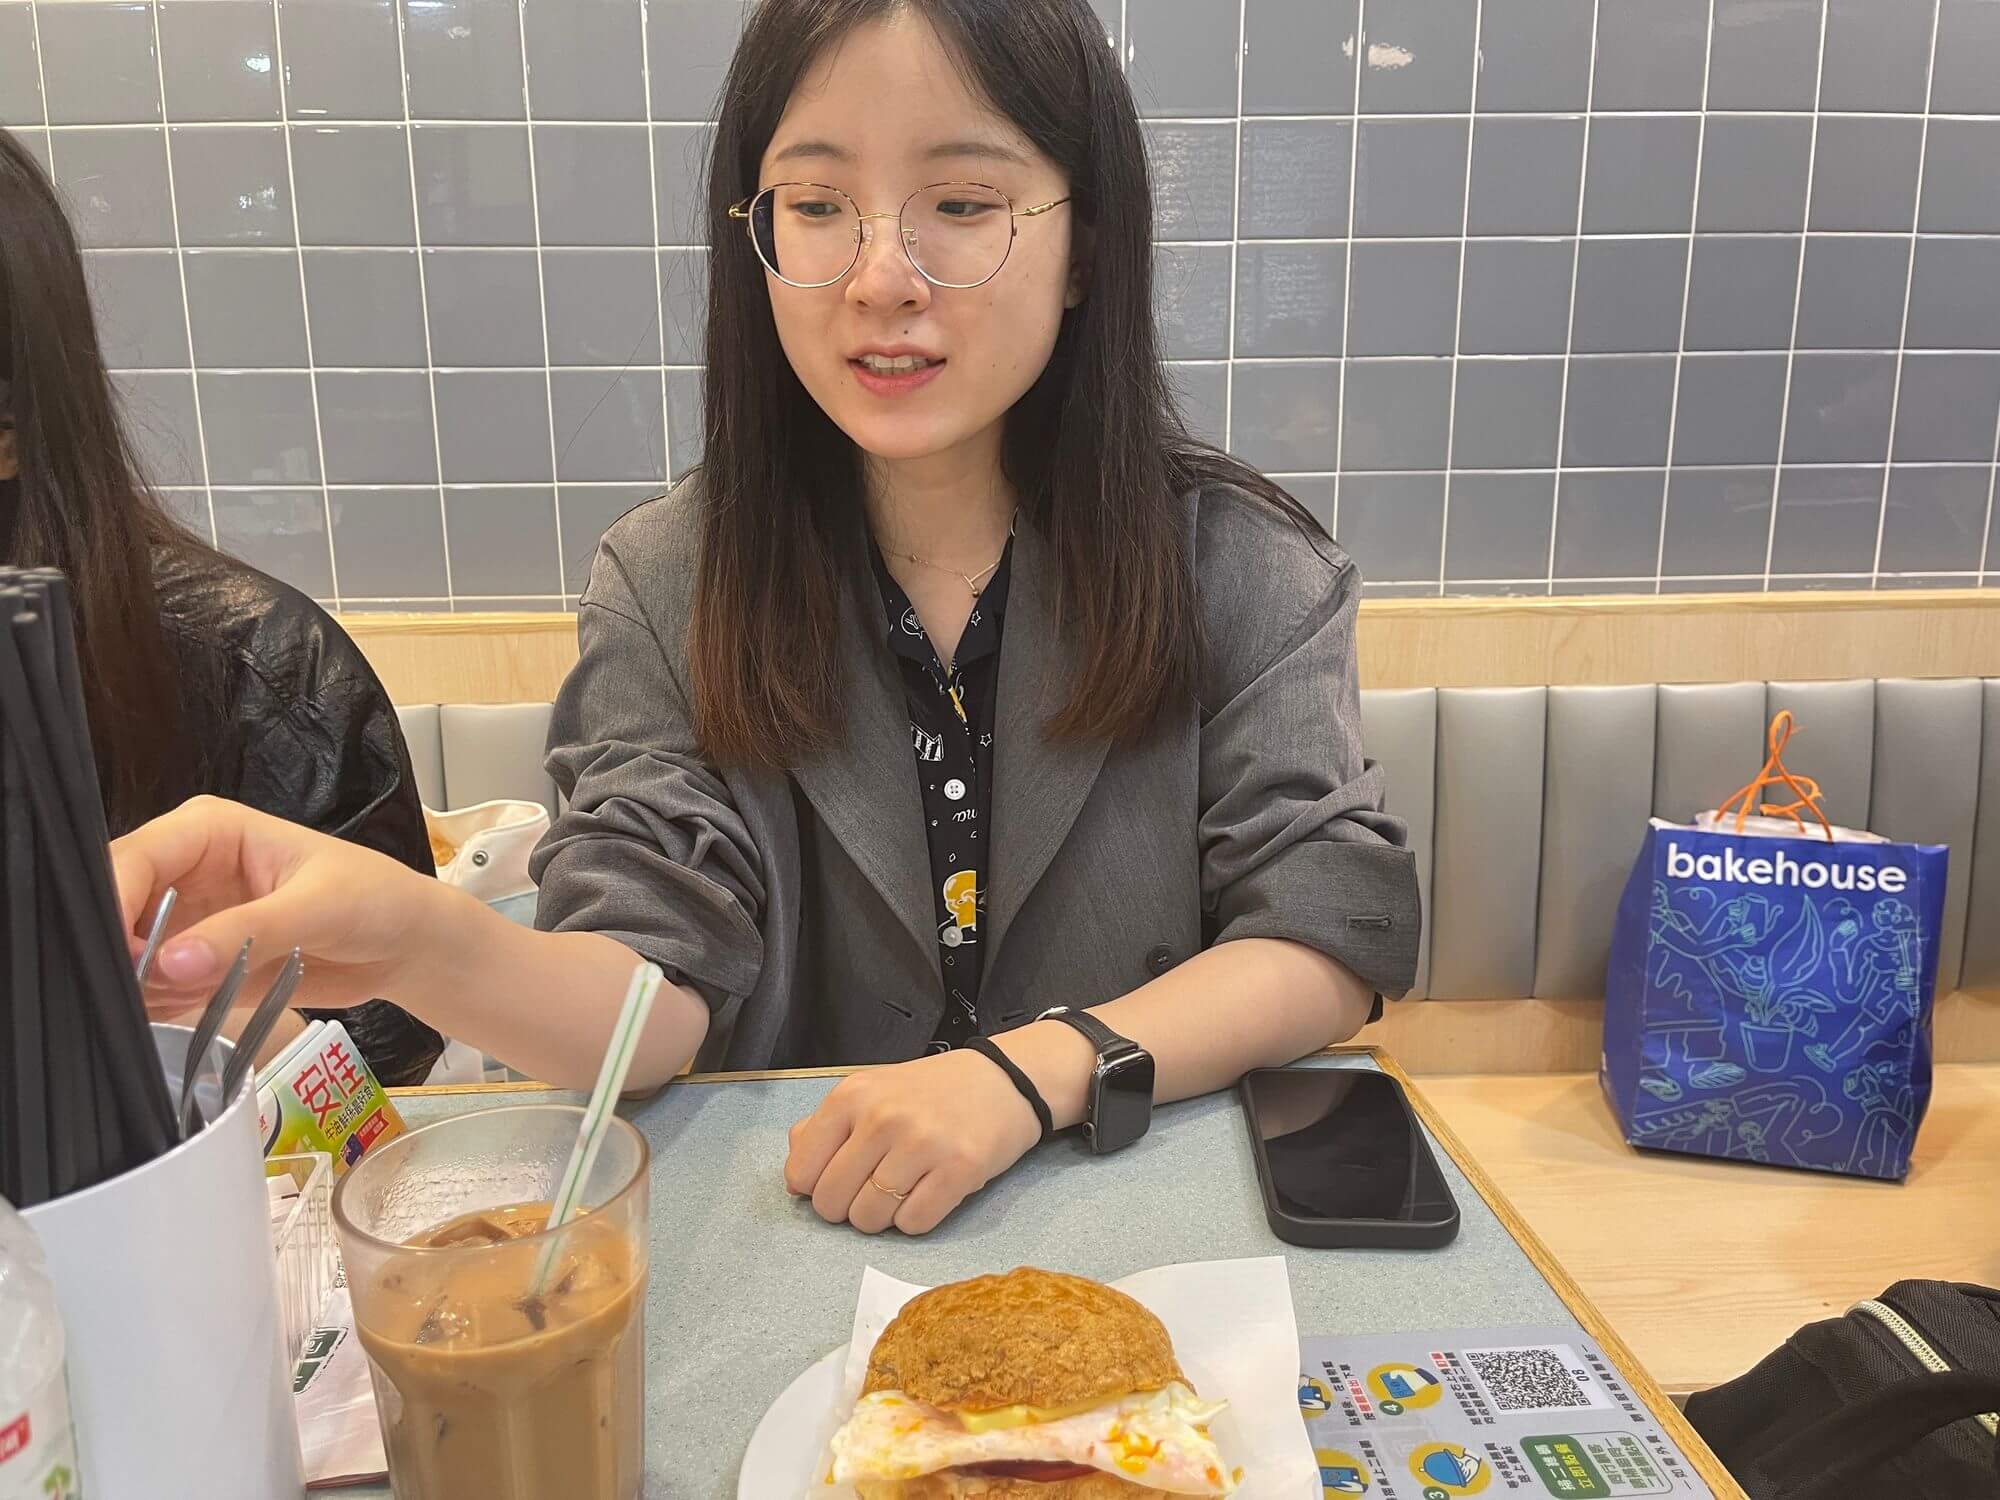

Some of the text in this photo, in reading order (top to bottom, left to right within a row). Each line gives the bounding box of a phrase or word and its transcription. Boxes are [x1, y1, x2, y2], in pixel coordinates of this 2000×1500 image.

[1667, 842, 1908, 894] bakehouse
[292, 1041, 366, 1129] 安佳
[1571, 1369, 1590, 1382] 08
[1382, 1403, 1400, 1413] 4
[1484, 1443, 1519, 1488] 等待服務員
[1501, 1446, 1533, 1483] 送上餐點
[1534, 1444, 1576, 1491] 掃二維碼
[1553, 1443, 1595, 1489] 立即點餐
[1587, 1444, 1625, 1485] 同行顧客
[1618, 1436, 1665, 1487] 二維碼點餐
[1428, 1491, 1445, 1500] 3
